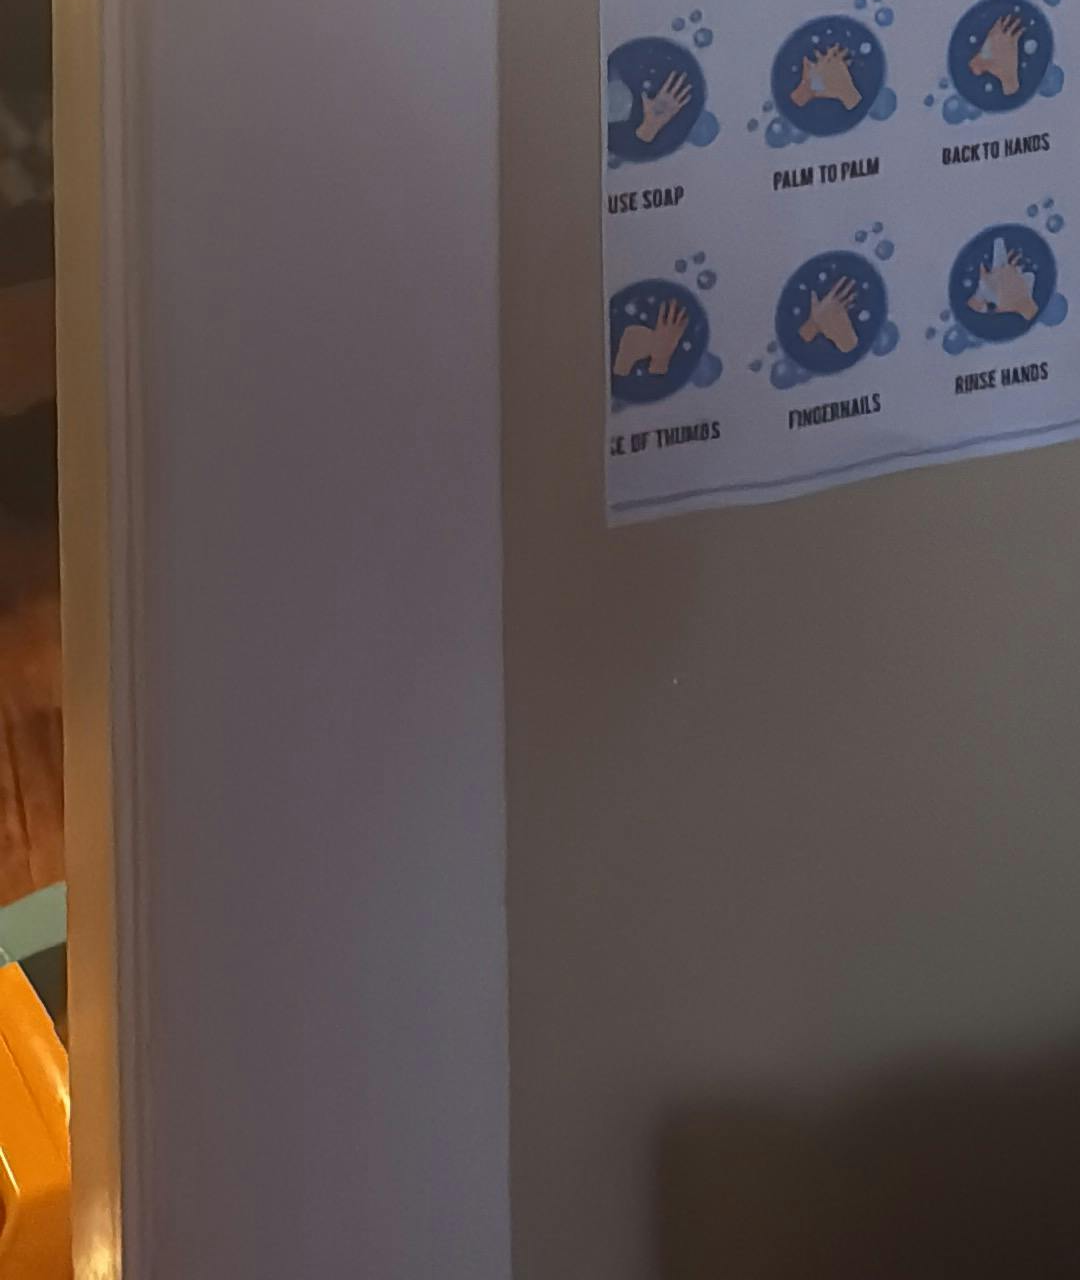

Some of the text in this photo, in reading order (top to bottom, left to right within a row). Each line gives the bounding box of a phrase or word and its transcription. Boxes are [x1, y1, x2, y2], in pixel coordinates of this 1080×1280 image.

[942, 133, 1051, 166] BACK TO HANDS
[773, 157, 880, 191] PALM TO PALM
[608, 186, 684, 215] USE SOAP
[955, 362, 1049, 395] RINSE HANDS
[788, 393, 881, 430] FINGERNAILS
[631, 432, 649, 453] OF
[656, 421, 721, 449] THUMBS
